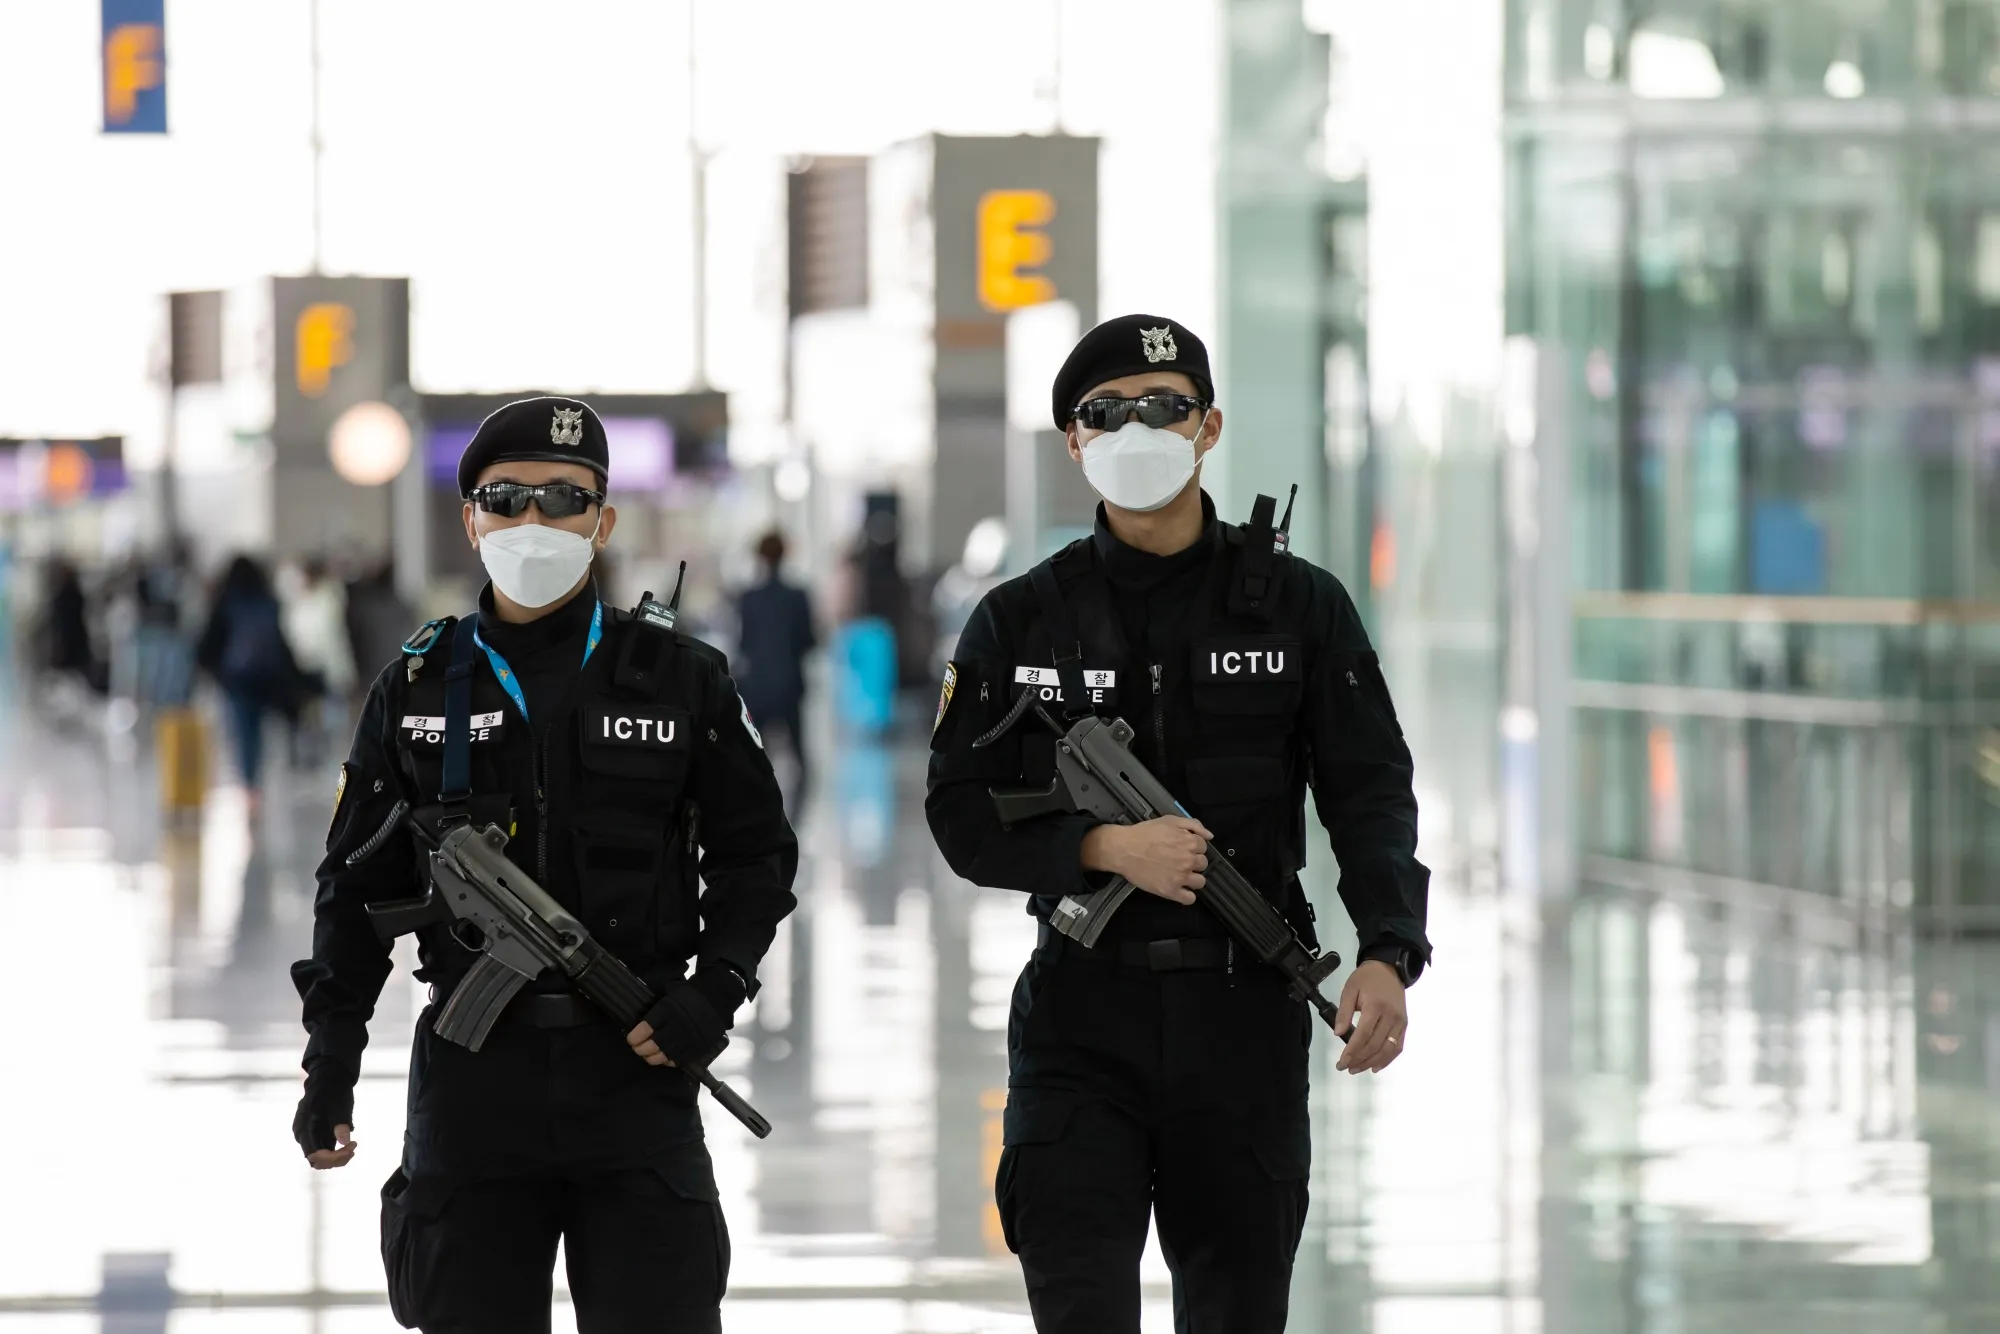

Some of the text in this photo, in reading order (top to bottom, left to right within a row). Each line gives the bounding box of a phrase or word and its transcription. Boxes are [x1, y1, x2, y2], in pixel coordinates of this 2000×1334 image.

[105, 23, 162, 125] F
[976, 189, 1056, 313] E
[296, 303, 356, 397] F
[1210, 651, 1284, 675] ICTU
[1039, 687, 1104, 703] OLE
[411, 728, 490, 744] POCE
[603, 715, 675, 743] ICTU
